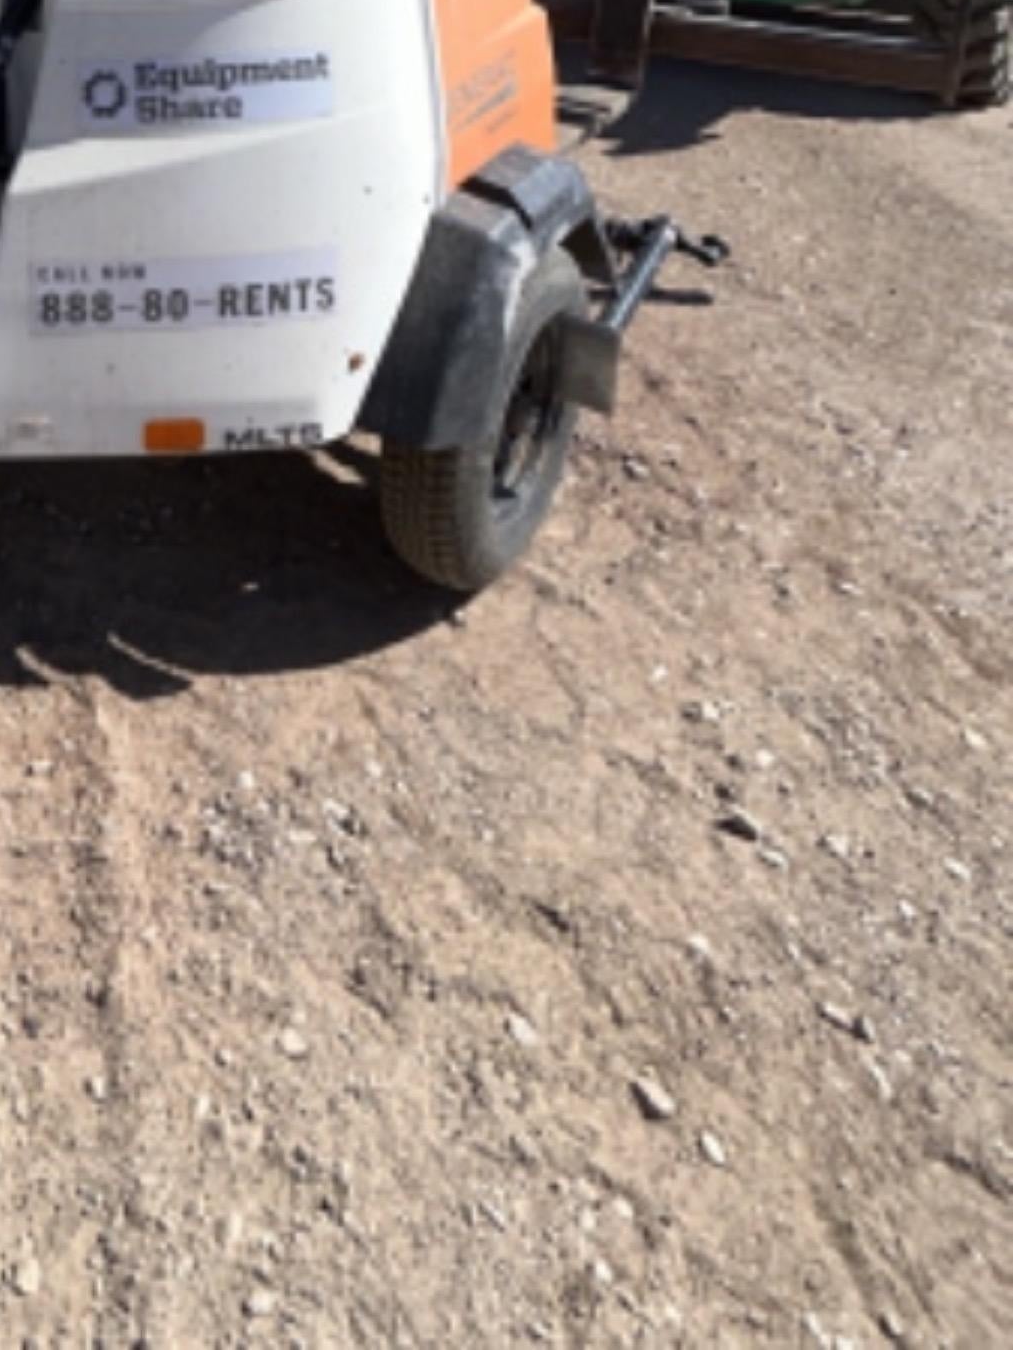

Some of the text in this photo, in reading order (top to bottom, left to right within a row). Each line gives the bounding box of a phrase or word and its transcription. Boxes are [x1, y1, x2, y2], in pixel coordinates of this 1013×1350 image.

[134, 53, 329, 93] Equipment
[134, 96, 243, 123] Share
[41, 278, 335, 327] 888-80-RENTS
